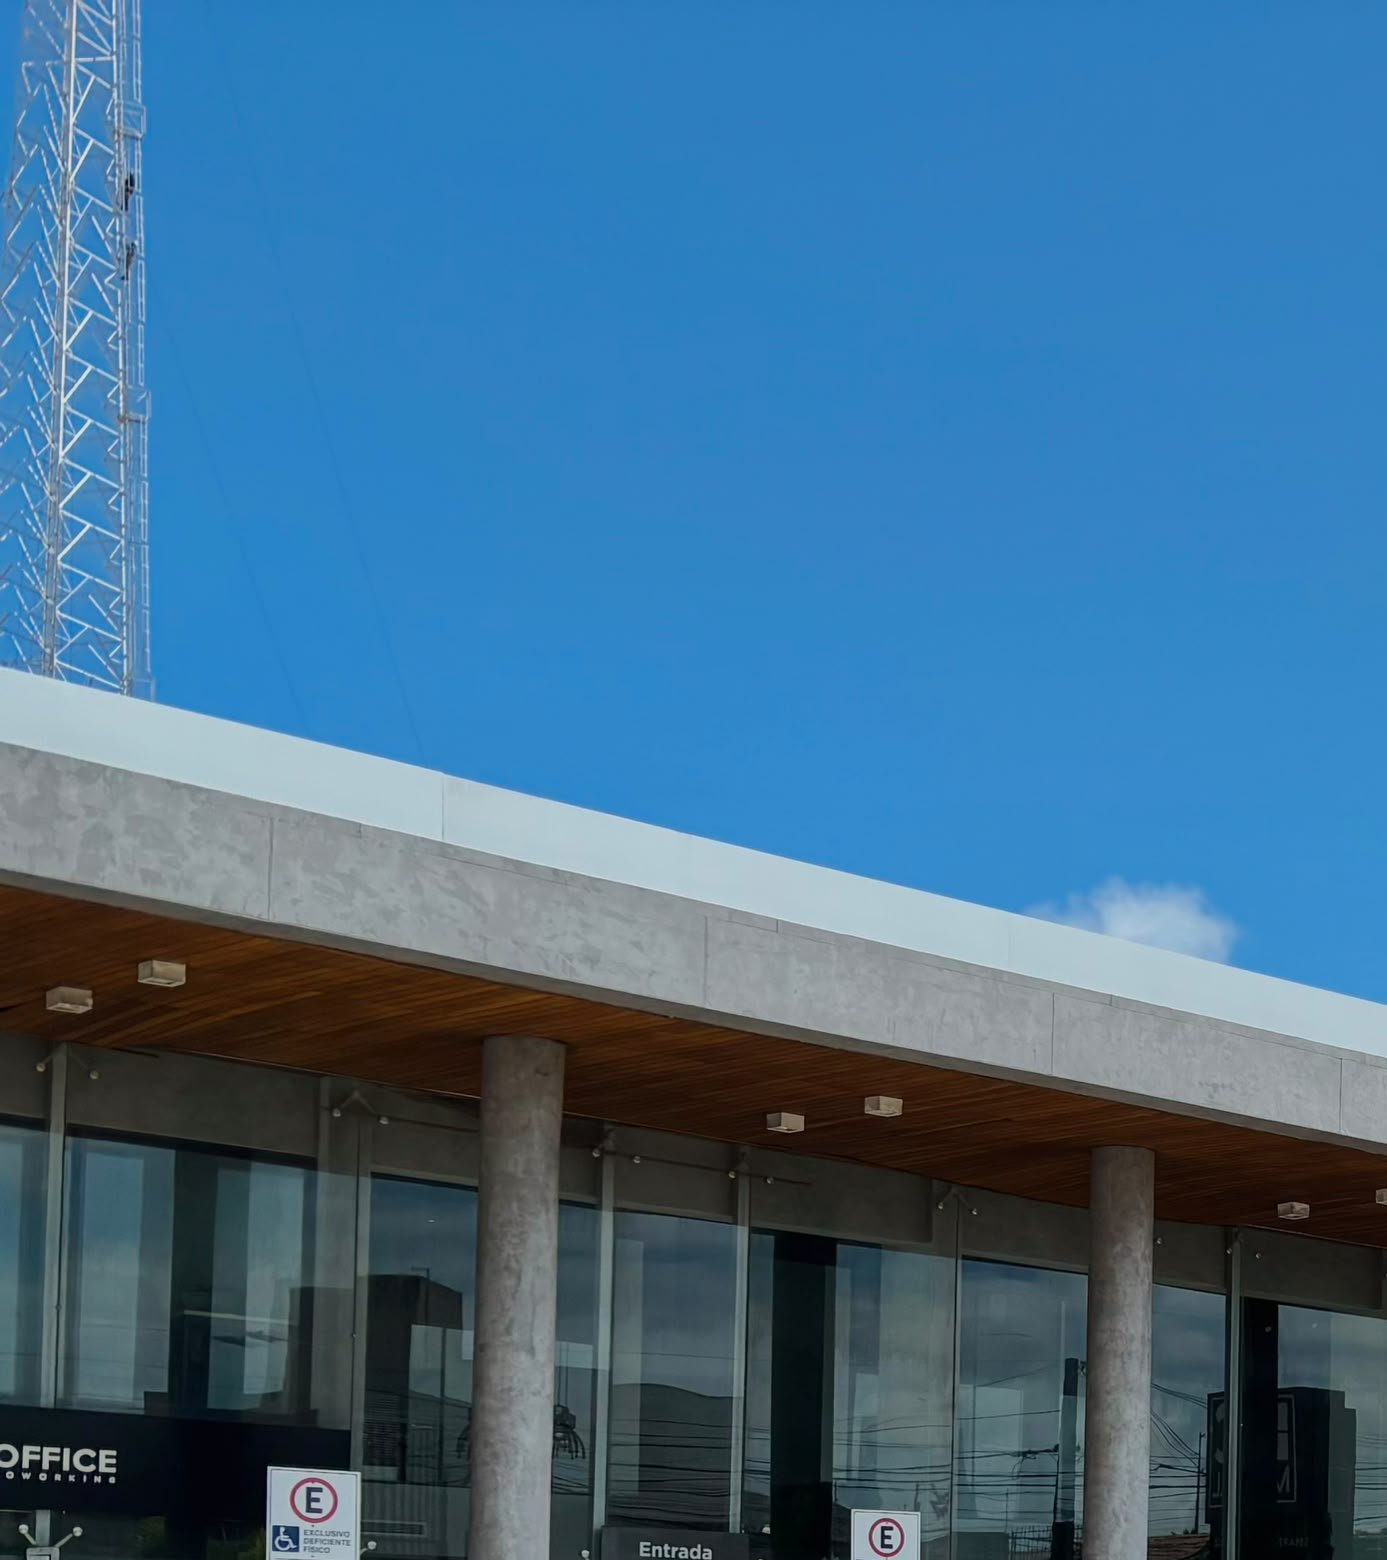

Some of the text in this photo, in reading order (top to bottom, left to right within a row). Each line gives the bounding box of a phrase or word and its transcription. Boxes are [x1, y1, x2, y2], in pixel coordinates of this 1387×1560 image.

[0, 1443, 118, 1474] OFFICE
[305, 1486, 324, 1514] E
[303, 1529, 351, 1538] EXCLUSIVO
[303, 1538, 352, 1547] DEFICIENTE
[880, 1525, 895, 1550] E
[638, 1541, 714, 1560] Entrada
